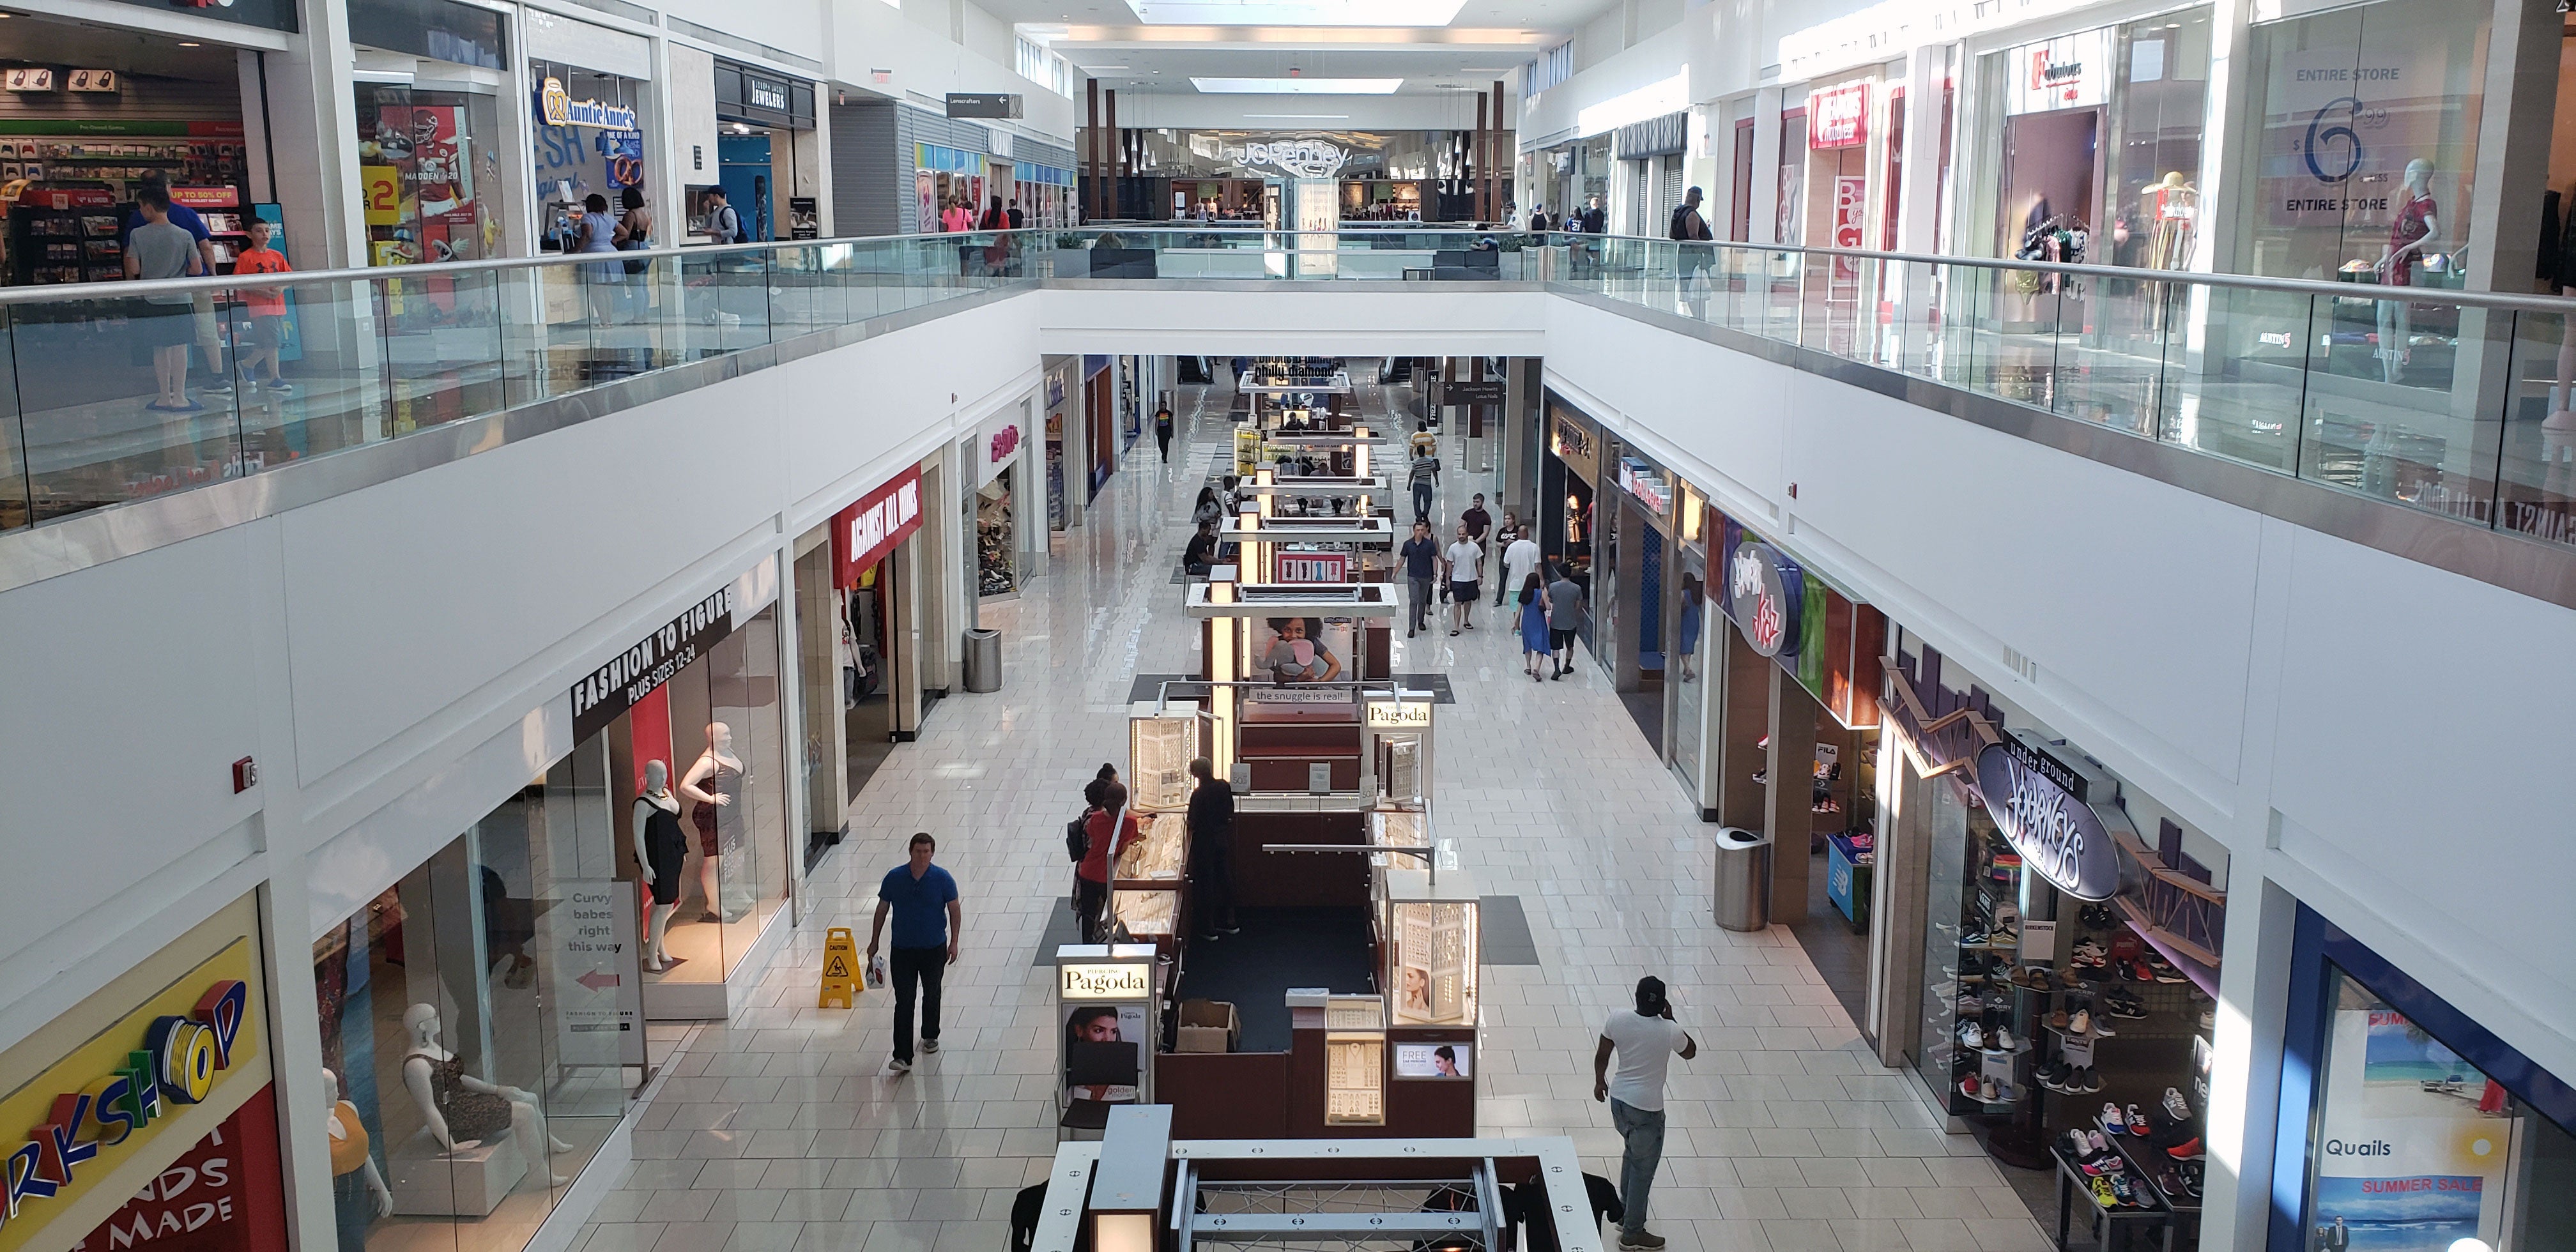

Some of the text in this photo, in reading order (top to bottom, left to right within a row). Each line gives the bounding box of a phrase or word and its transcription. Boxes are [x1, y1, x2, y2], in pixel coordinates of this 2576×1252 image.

[876, 73, 889, 84] EXIT
[2296, 68, 2400, 81] ENTIRE STORE
[752, 80, 785, 109] JEWELERS
[567, 100, 636, 128] Auntie Anne's
[617, 131, 623, 139] OF
[629, 131, 640, 139] KIND
[2293, 96, 2387, 183] $ 6 99
[1238, 142, 1349, 169] JCPenney
[405, 171, 458, 181] MADDEN 20
[372, 179, 395, 211] 2
[2287, 198, 2388, 211] ENTIRE STORE
[1572, 223, 1580, 231] 21
[1255, 365, 1335, 382] philly diamond
[851, 501, 884, 563] AGAINST
[885, 492, 900, 537] ALL
[575, 585, 732, 717] FASHION TO FIGURE
[627, 643, 696, 706] PLUS SIZES 12-24
[1256, 691, 1343, 703] the snuggle is real!
[1370, 707, 1427, 724] Pagoda
[1818, 746, 1836, 755] FILA
[2010, 742, 2075, 791] under ground
[1232, 776, 1243, 784] 50
[2005, 756, 2084, 889] JOURNEYS
[723, 838, 736, 857] PLUS
[572, 892, 613, 905] Curvy
[1979, 889, 1991, 910] VANS
[573, 909, 613, 919] babes
[579, 925, 610, 938] right
[568, 941, 622, 954] this way
[1064, 970, 1146, 994] Pagoda
[1402, 1051, 1427, 1060] FREE
[1108, 1085, 1135, 1095] golden
[2195, 1076, 2209, 1099] ne
[0, 979, 246, 1233] RKSHOP
[2326, 1139, 2391, 1157] Quails
[2362, 1178, 2483, 1194] SUMMER SALE
[109, 1196, 233, 1251] MADE
